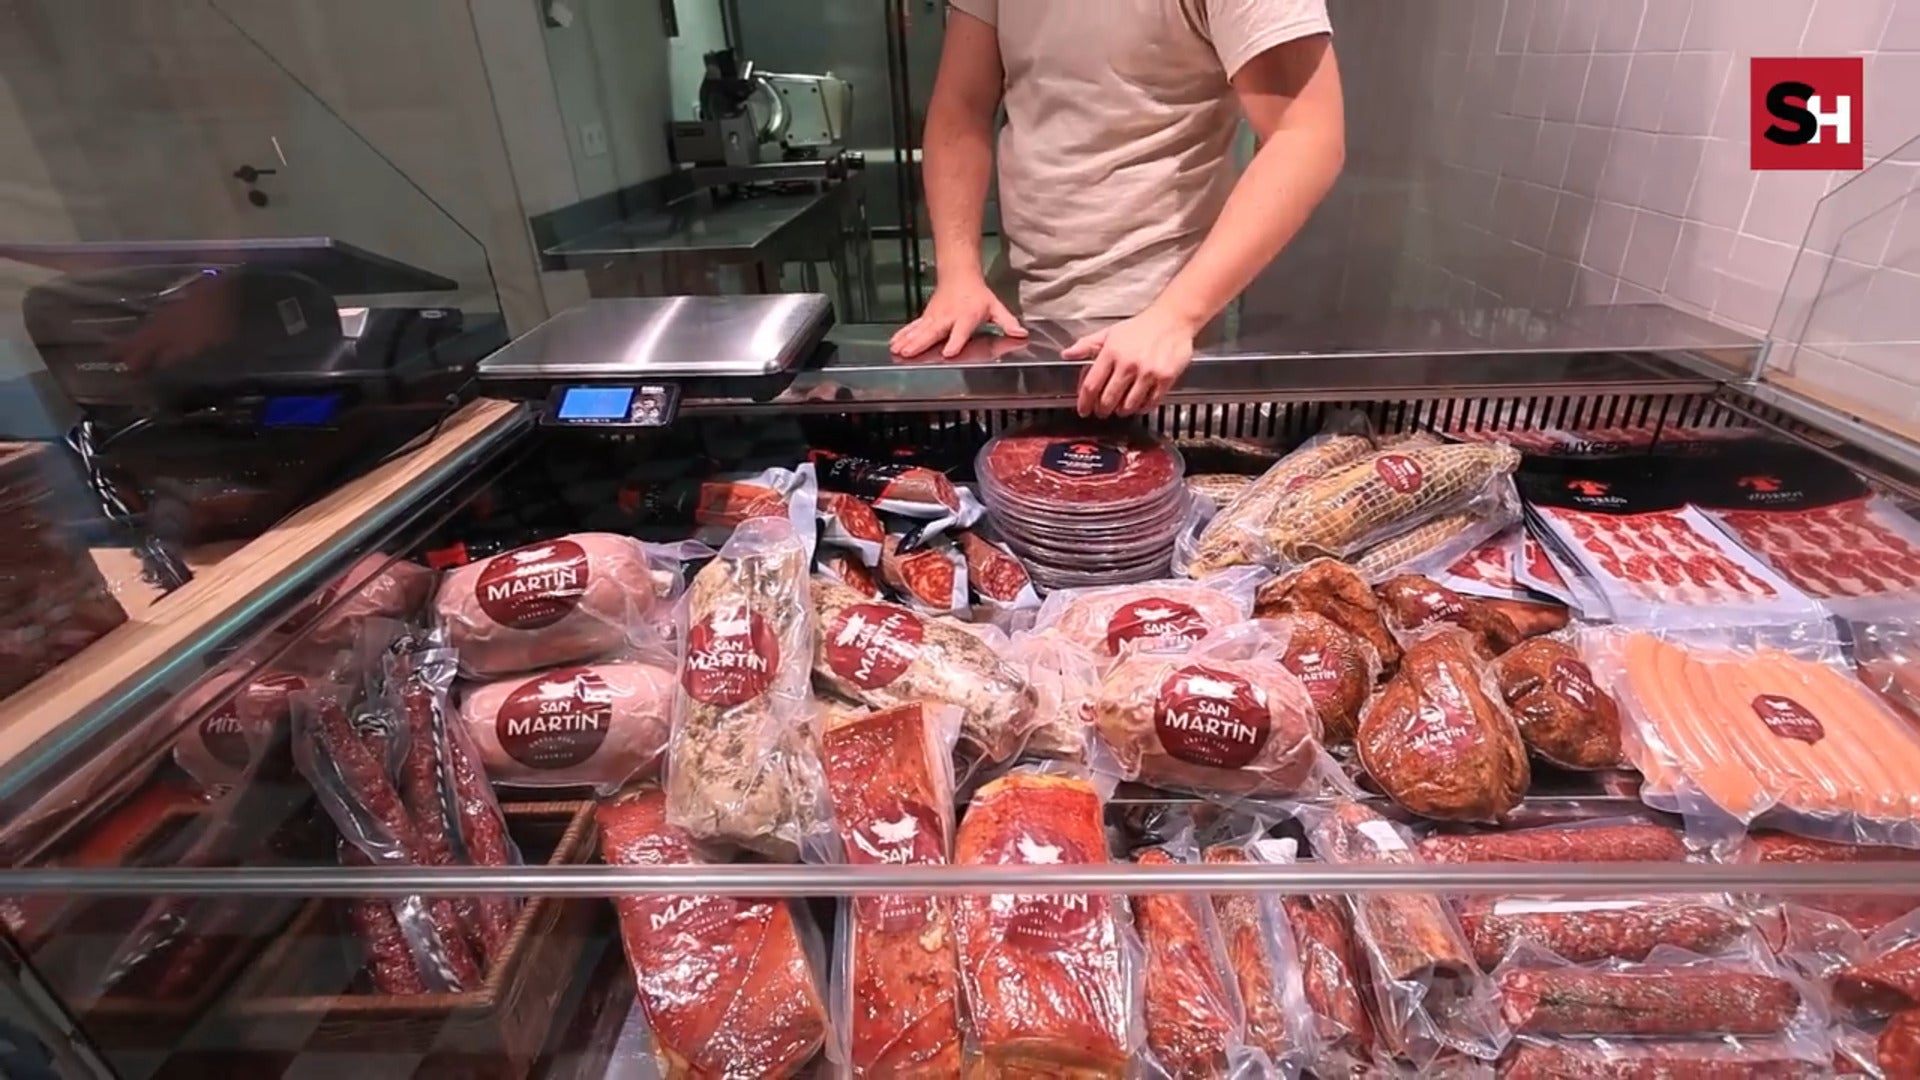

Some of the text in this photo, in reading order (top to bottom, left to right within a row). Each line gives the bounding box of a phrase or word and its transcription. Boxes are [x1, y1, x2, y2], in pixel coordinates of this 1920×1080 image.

[713, 640, 744, 652] SAN
[539, 700, 572, 714] SAN
[1197, 700, 1230, 718] SAN
[880, 846, 914, 866] SAN
